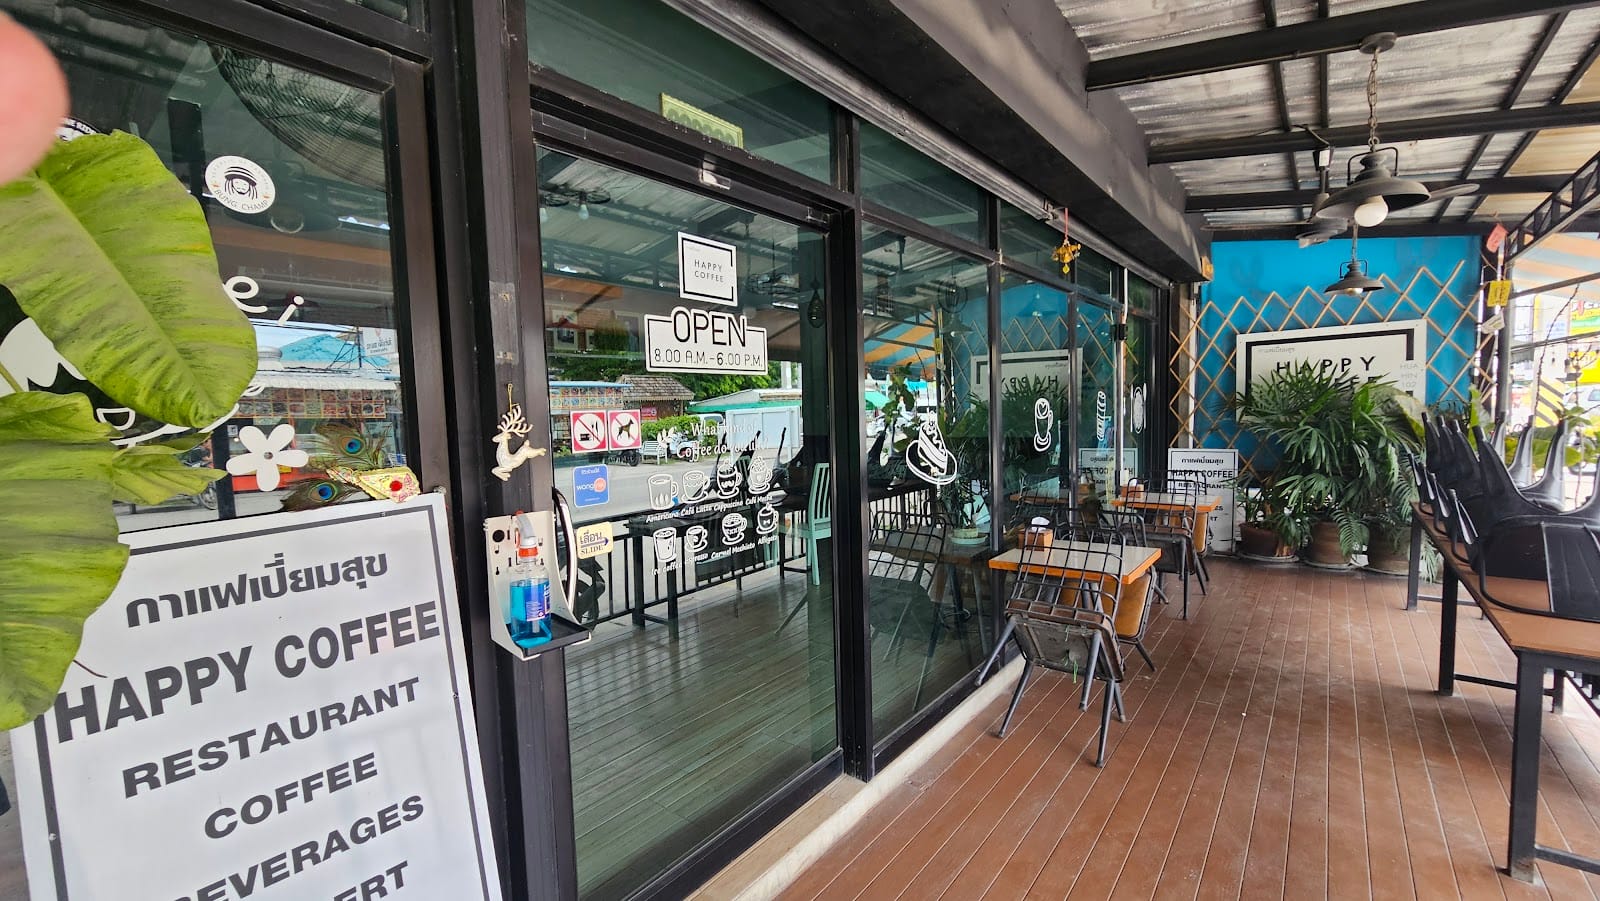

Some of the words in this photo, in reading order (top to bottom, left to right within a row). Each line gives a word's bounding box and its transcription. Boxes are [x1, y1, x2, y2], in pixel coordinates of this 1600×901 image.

[694, 259, 722, 272] HAPPY
[694, 271, 724, 283] COFFEE
[673, 310, 746, 347] OPEN
[655, 348, 681, 363] 8.00
[744, 354, 764, 367] P.M.
[1276, 355, 1376, 375] HAPPY
[676, 440, 712, 463] Coffee
[580, 529, 602, 545] เลื่อน
[581, 545, 604, 555] SLIDE
[126, 553, 388, 628] กาแฟเปี่ยมสุข
[56, 645, 253, 743] HAPPY
[274, 601, 441, 678] COFFEE
[122, 677, 420, 799] RESTAURANT
[204, 752, 379, 840] COFFEE
[175, 795, 424, 901] EVERAGES
